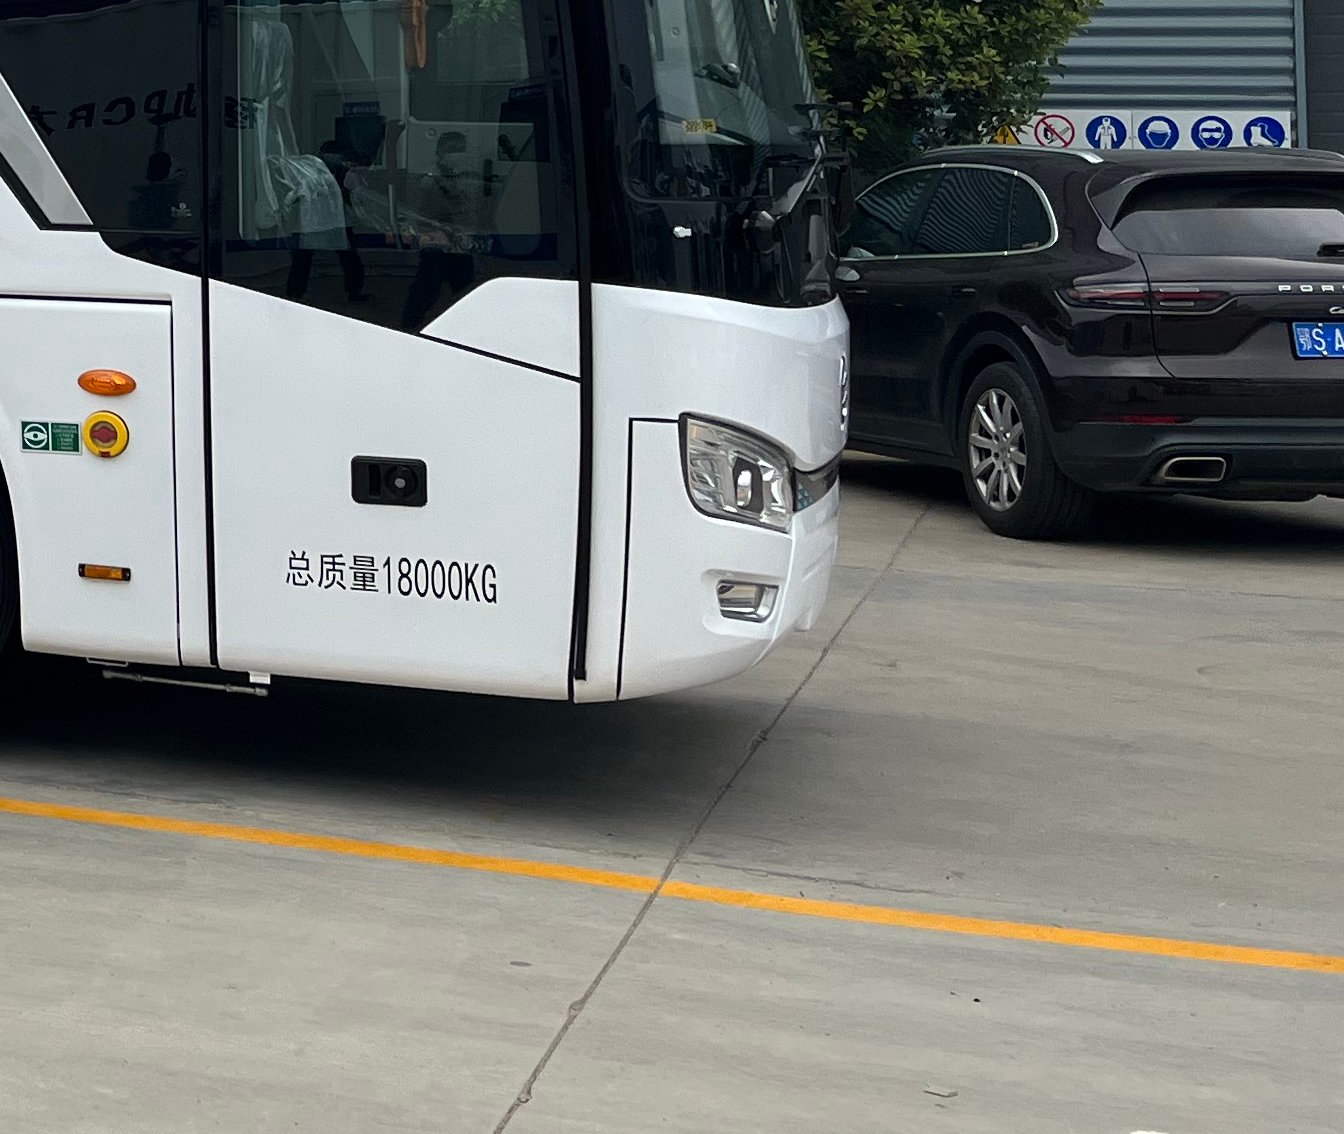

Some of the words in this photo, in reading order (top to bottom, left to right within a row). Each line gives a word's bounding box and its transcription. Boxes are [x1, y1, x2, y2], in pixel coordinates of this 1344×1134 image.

[1278, 284, 1344, 292] POR
[286, 550, 498, 604] 总质量18000KG
